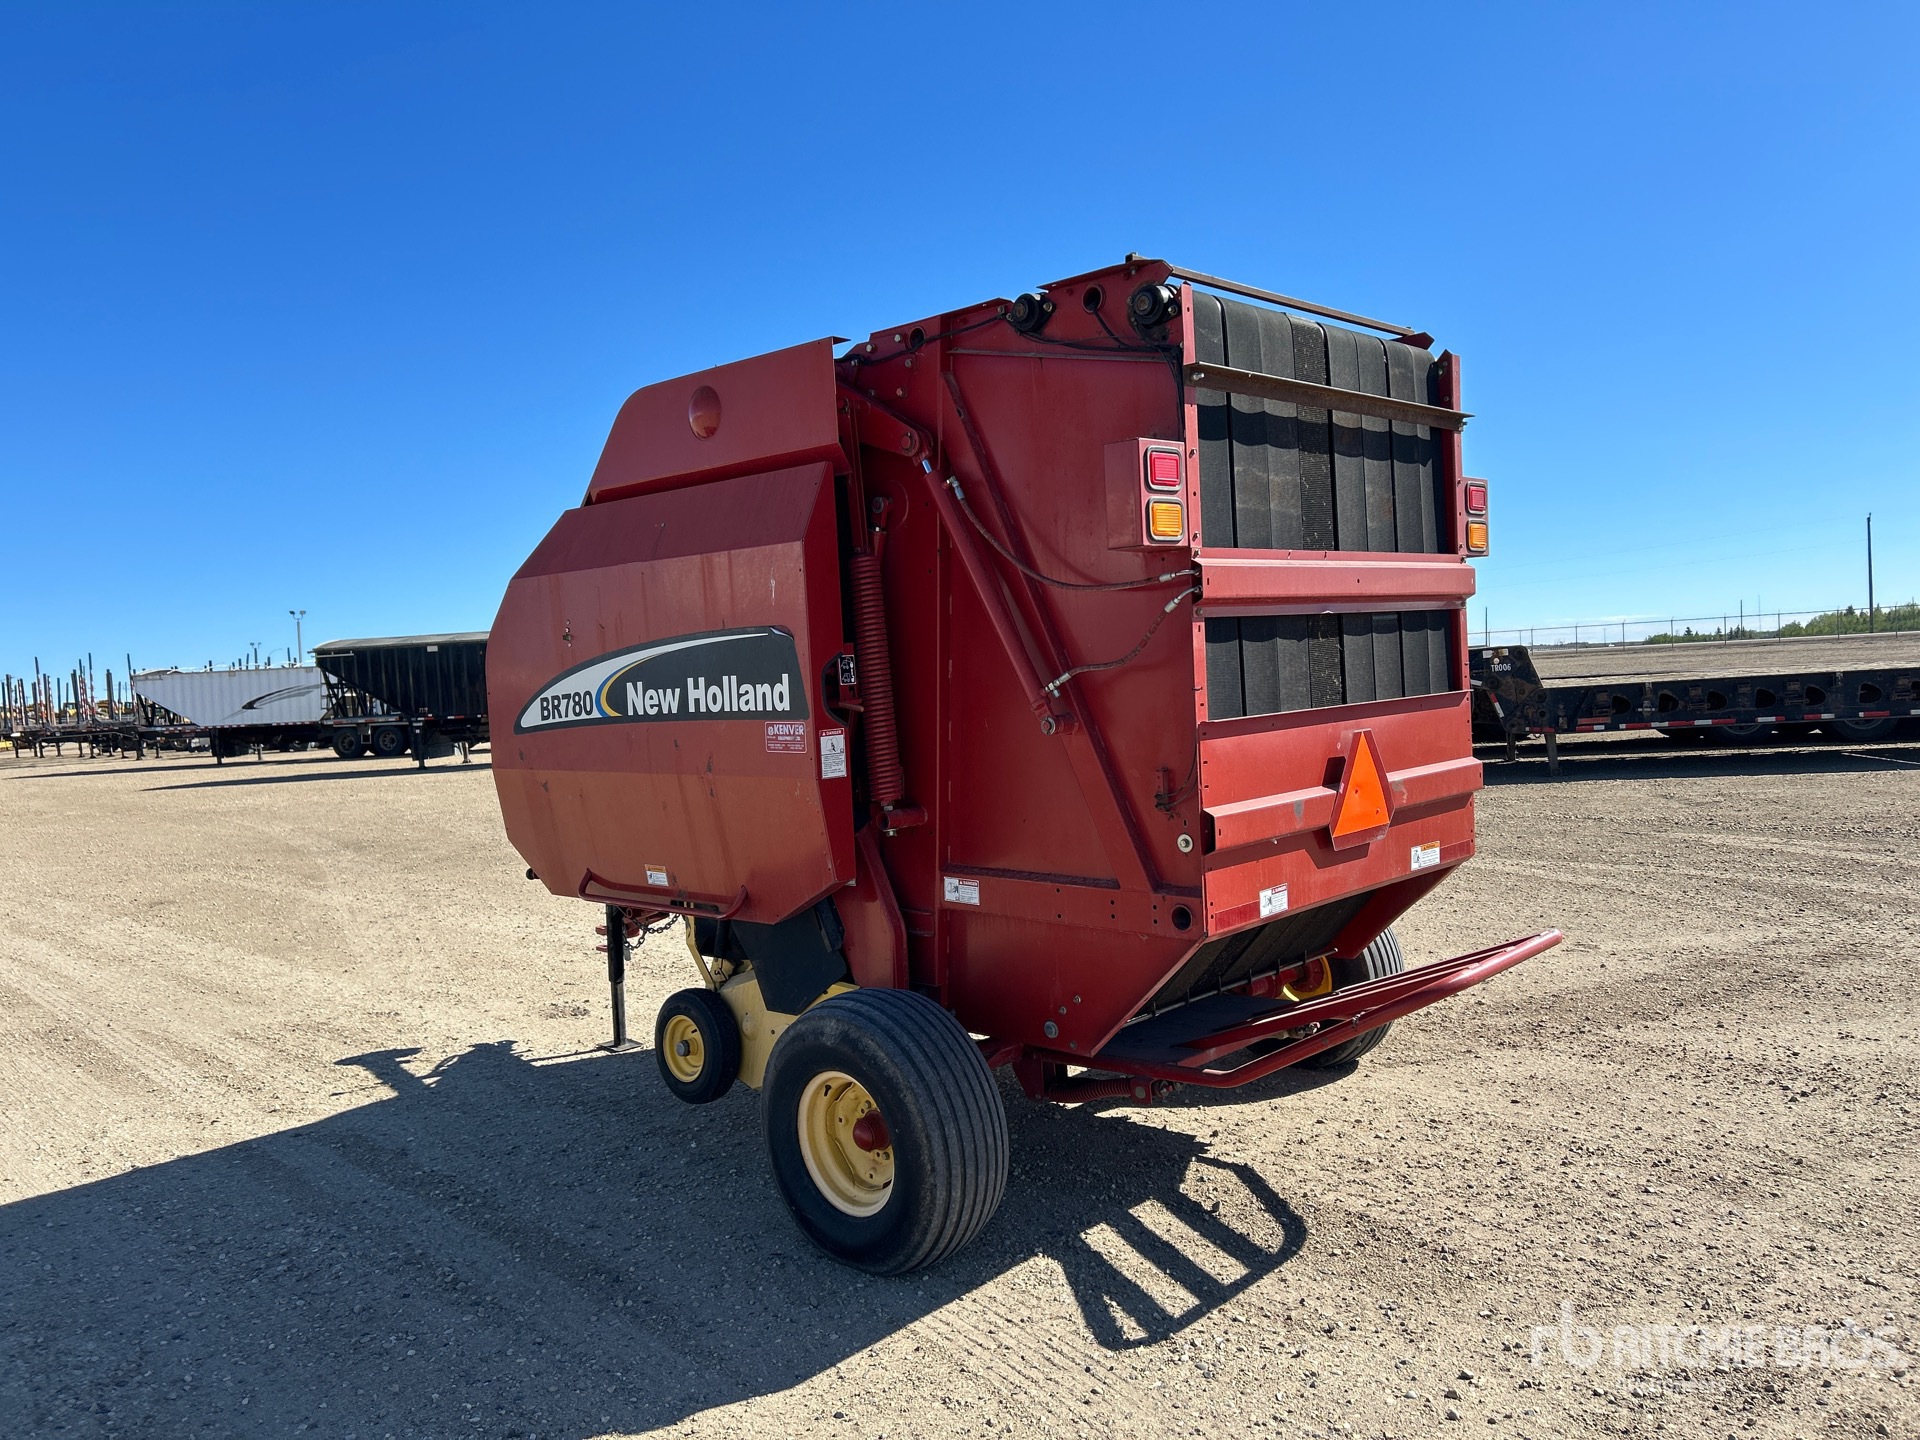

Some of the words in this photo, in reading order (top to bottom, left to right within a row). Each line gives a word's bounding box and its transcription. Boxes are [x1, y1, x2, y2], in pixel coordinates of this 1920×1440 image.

[1491, 663, 1512, 672] TR006
[626, 681, 680, 716] New
[687, 673, 790, 713] Holland
[540, 690, 594, 721] BR780
[773, 724, 804, 735] KENVER
